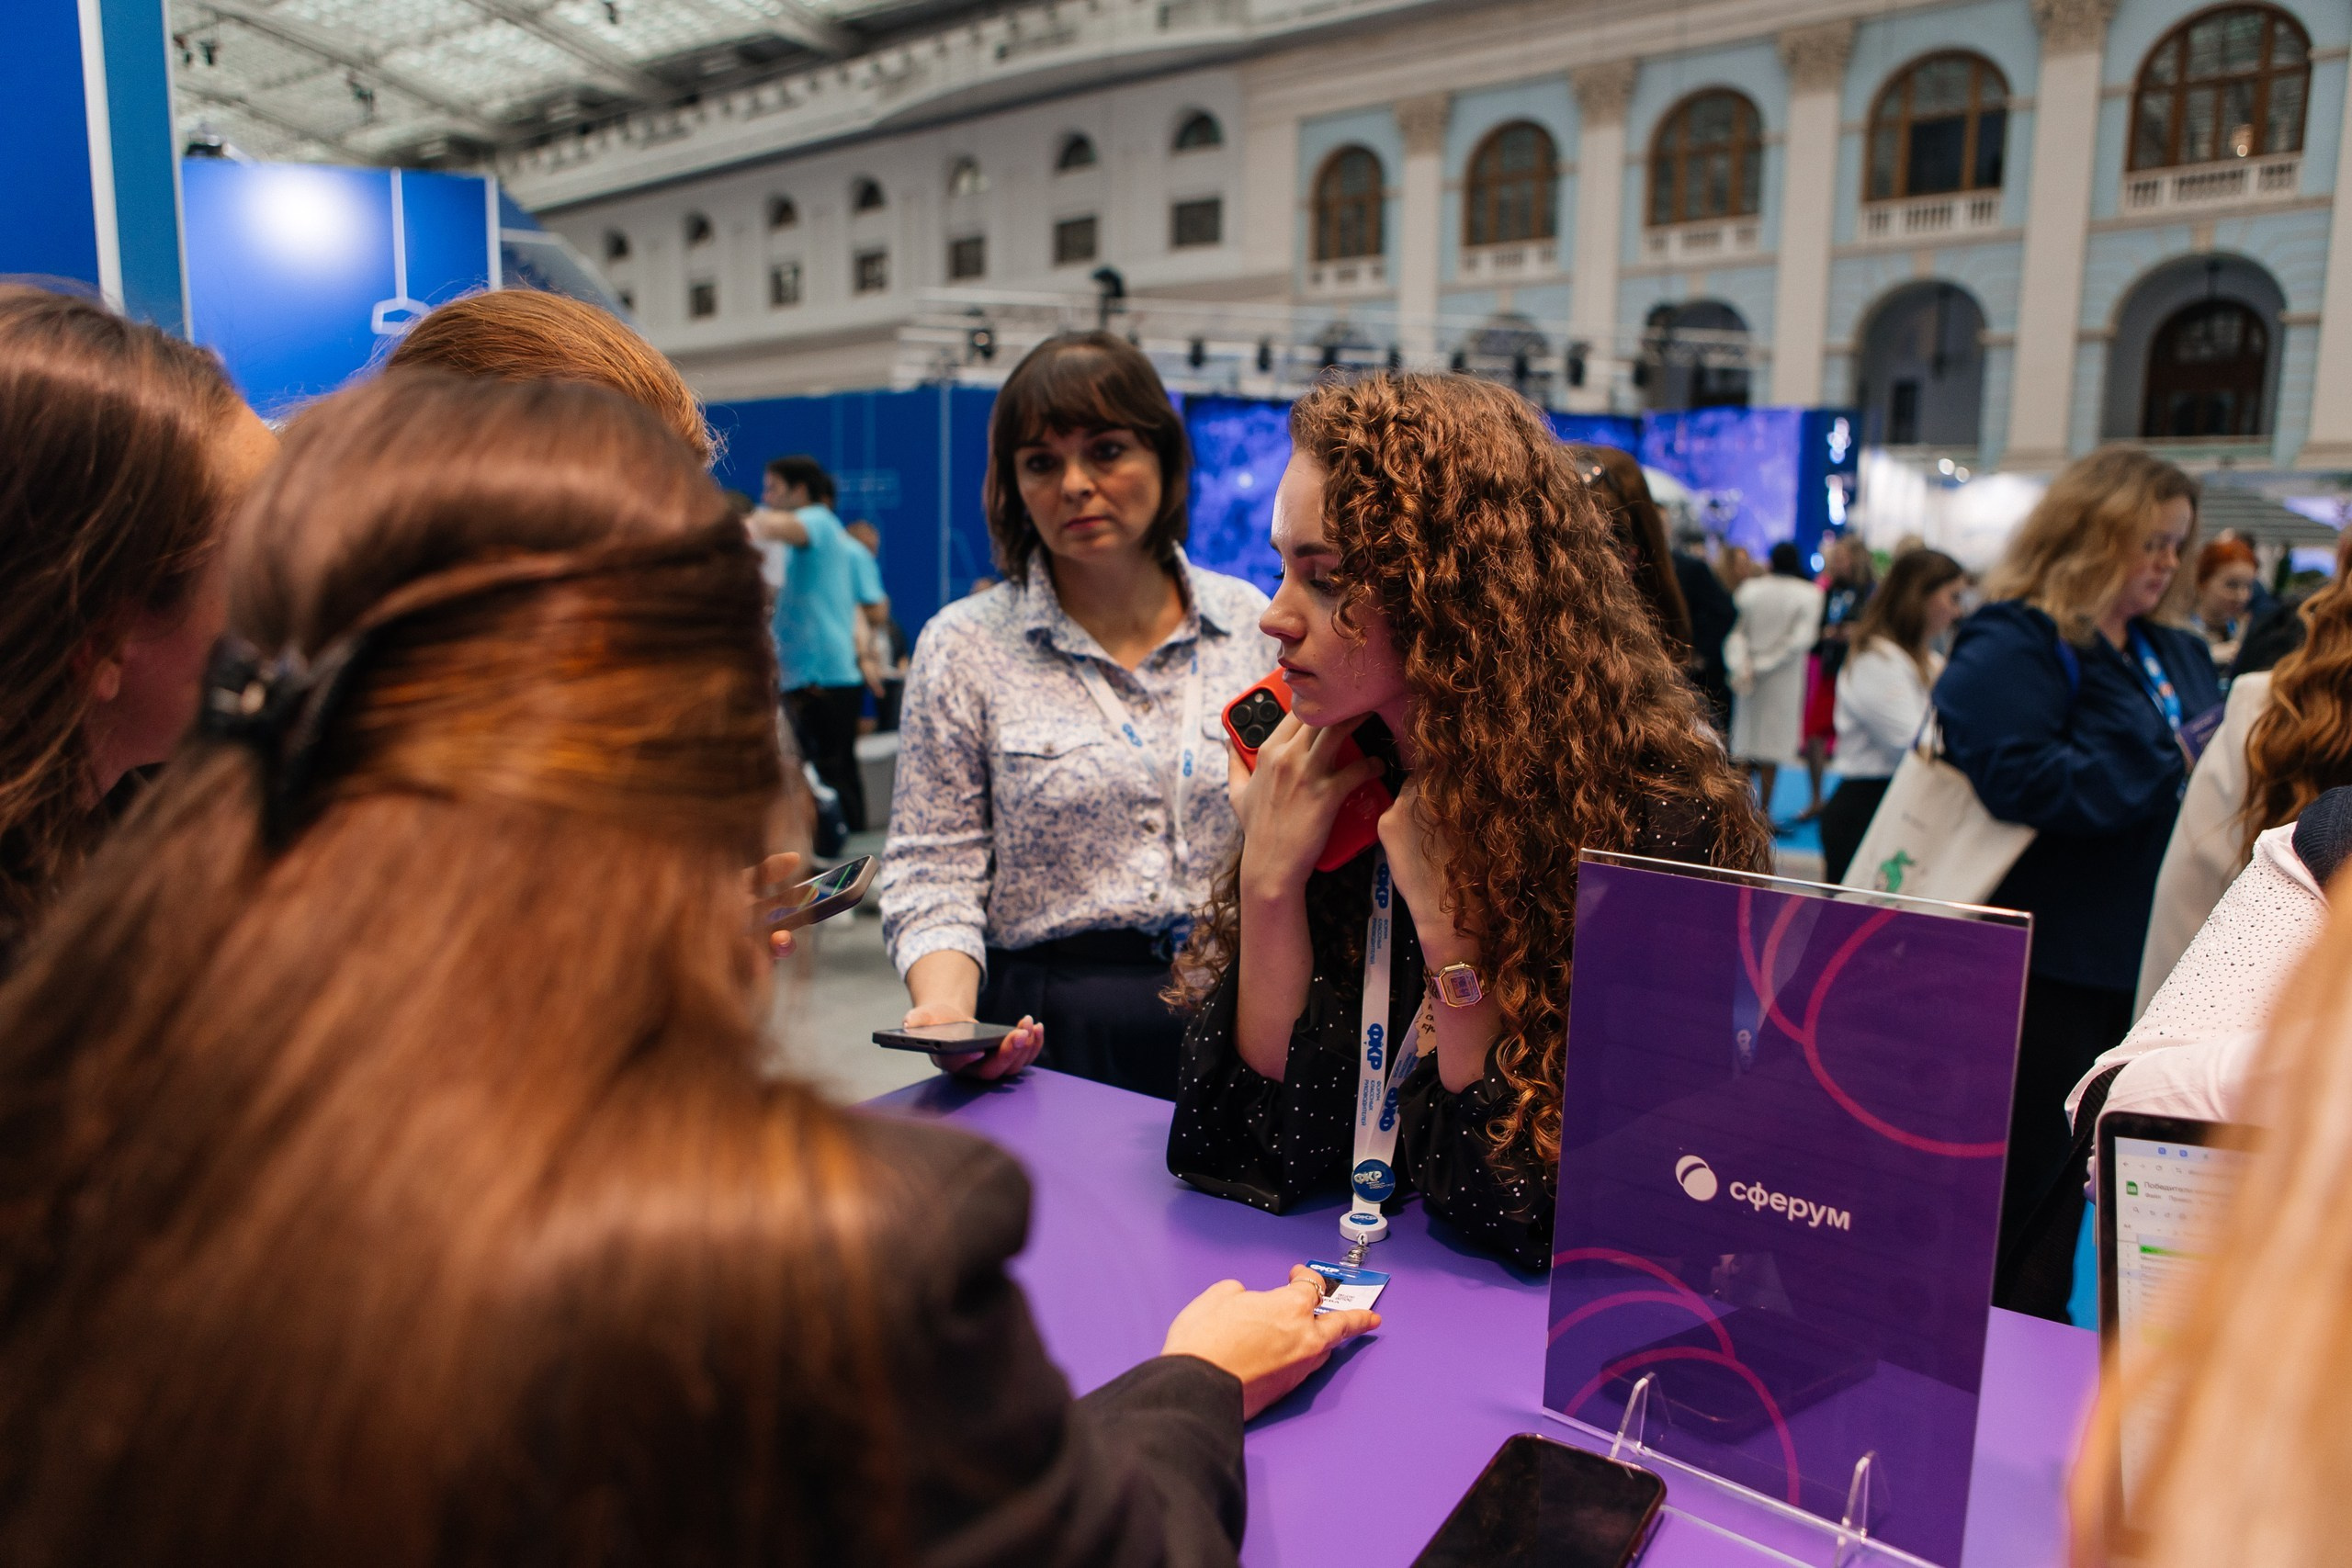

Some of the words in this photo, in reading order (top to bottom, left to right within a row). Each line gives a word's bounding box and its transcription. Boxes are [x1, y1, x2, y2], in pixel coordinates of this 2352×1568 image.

[1375, 863, 1389, 908] ФКР
[1367, 1022, 1384, 1070] ФКР
[1361, 1079, 1370, 1126] РУКОВОДИТЕЛЕЙ
[1354, 1171, 1383, 1185] ФКР
[1730, 1182, 1850, 1231] сферум
